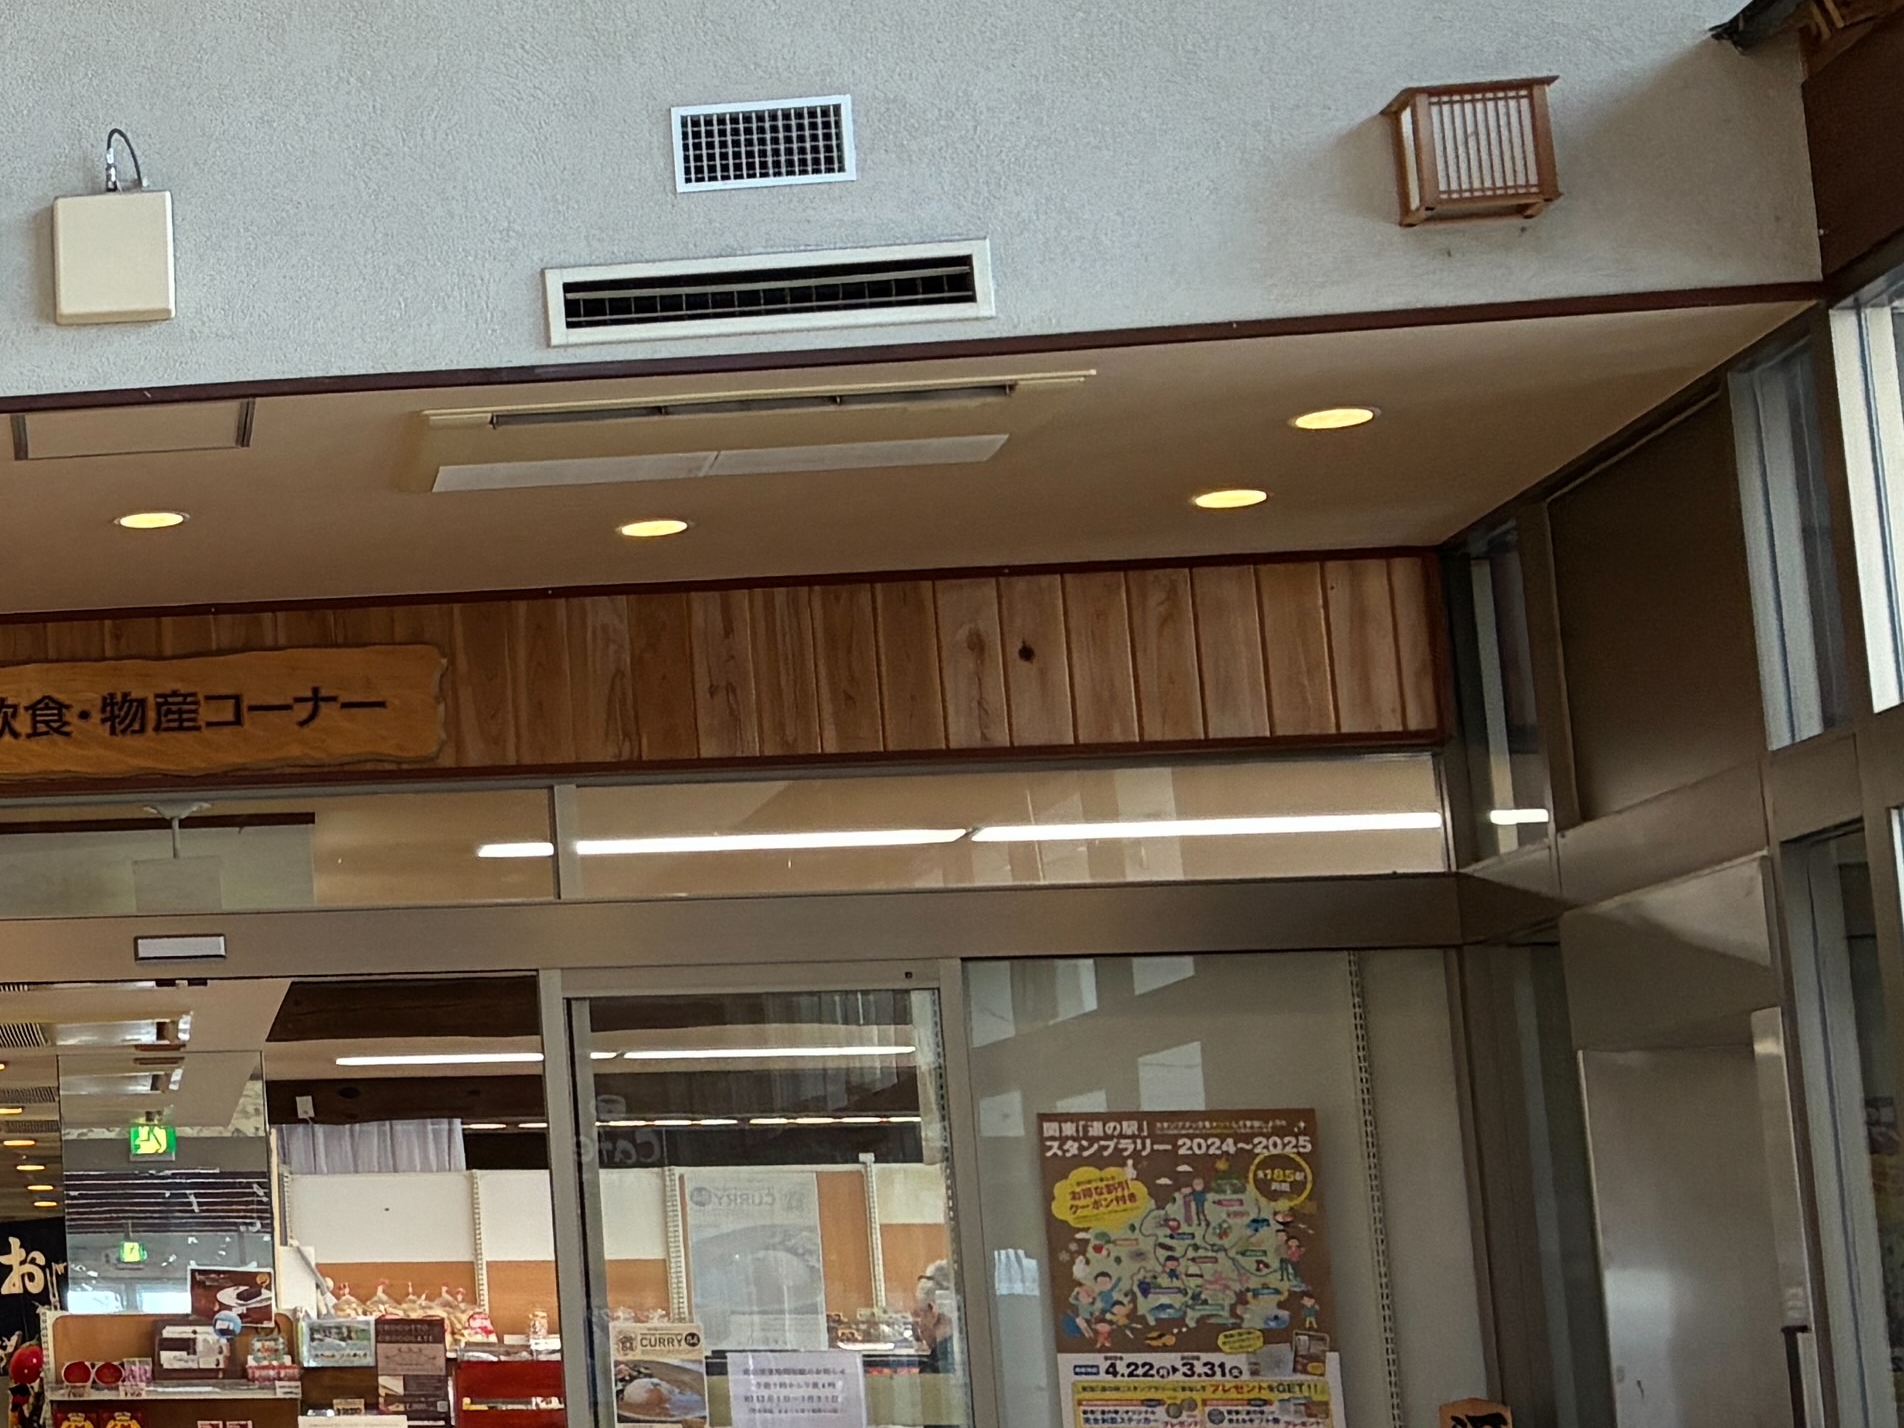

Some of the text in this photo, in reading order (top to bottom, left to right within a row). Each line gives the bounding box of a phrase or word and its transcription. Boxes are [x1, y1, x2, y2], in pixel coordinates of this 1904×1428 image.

[1045, 1139, 1173, 1158] スタンプラリー
[639, 1335, 684, 1349] CURRY
[1104, 1362, 1155, 1379] 4.22
[1181, 1361, 1228, 1378] 3.31
